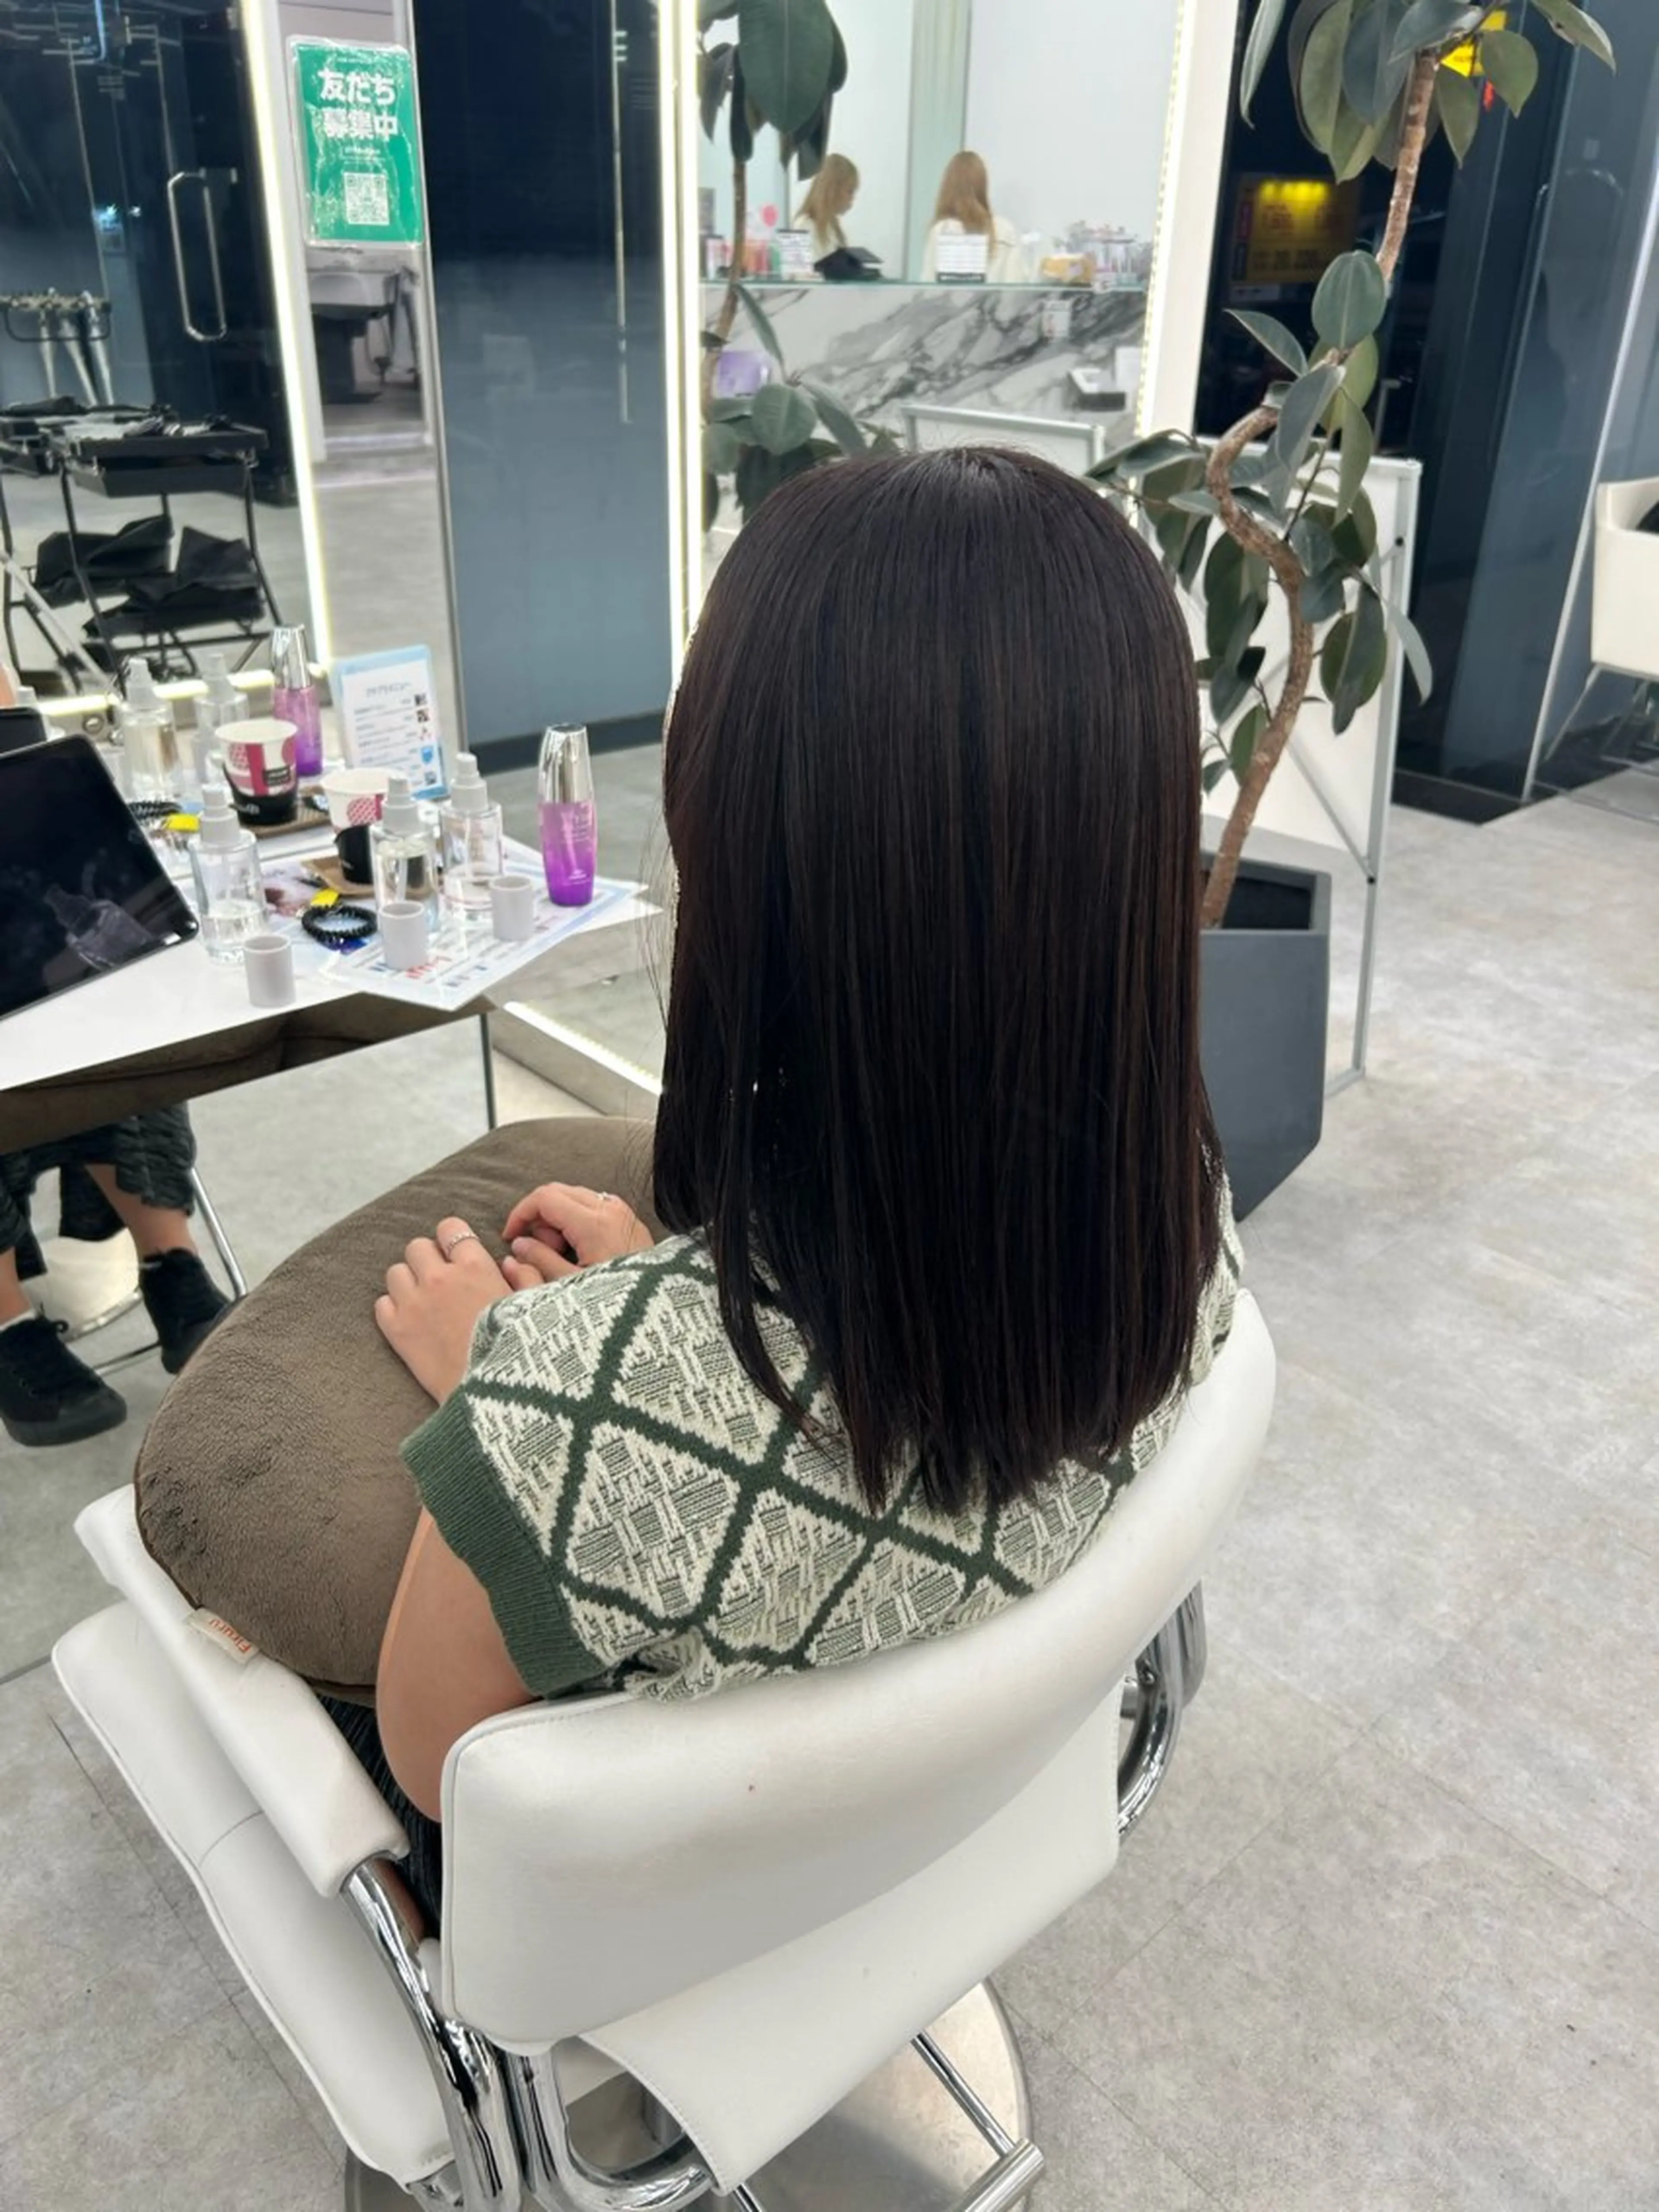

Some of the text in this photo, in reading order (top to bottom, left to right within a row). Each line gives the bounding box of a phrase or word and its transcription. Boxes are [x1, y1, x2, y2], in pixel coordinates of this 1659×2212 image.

[318, 67, 396, 105] 友だち
[321, 108, 398, 142] 募集中
